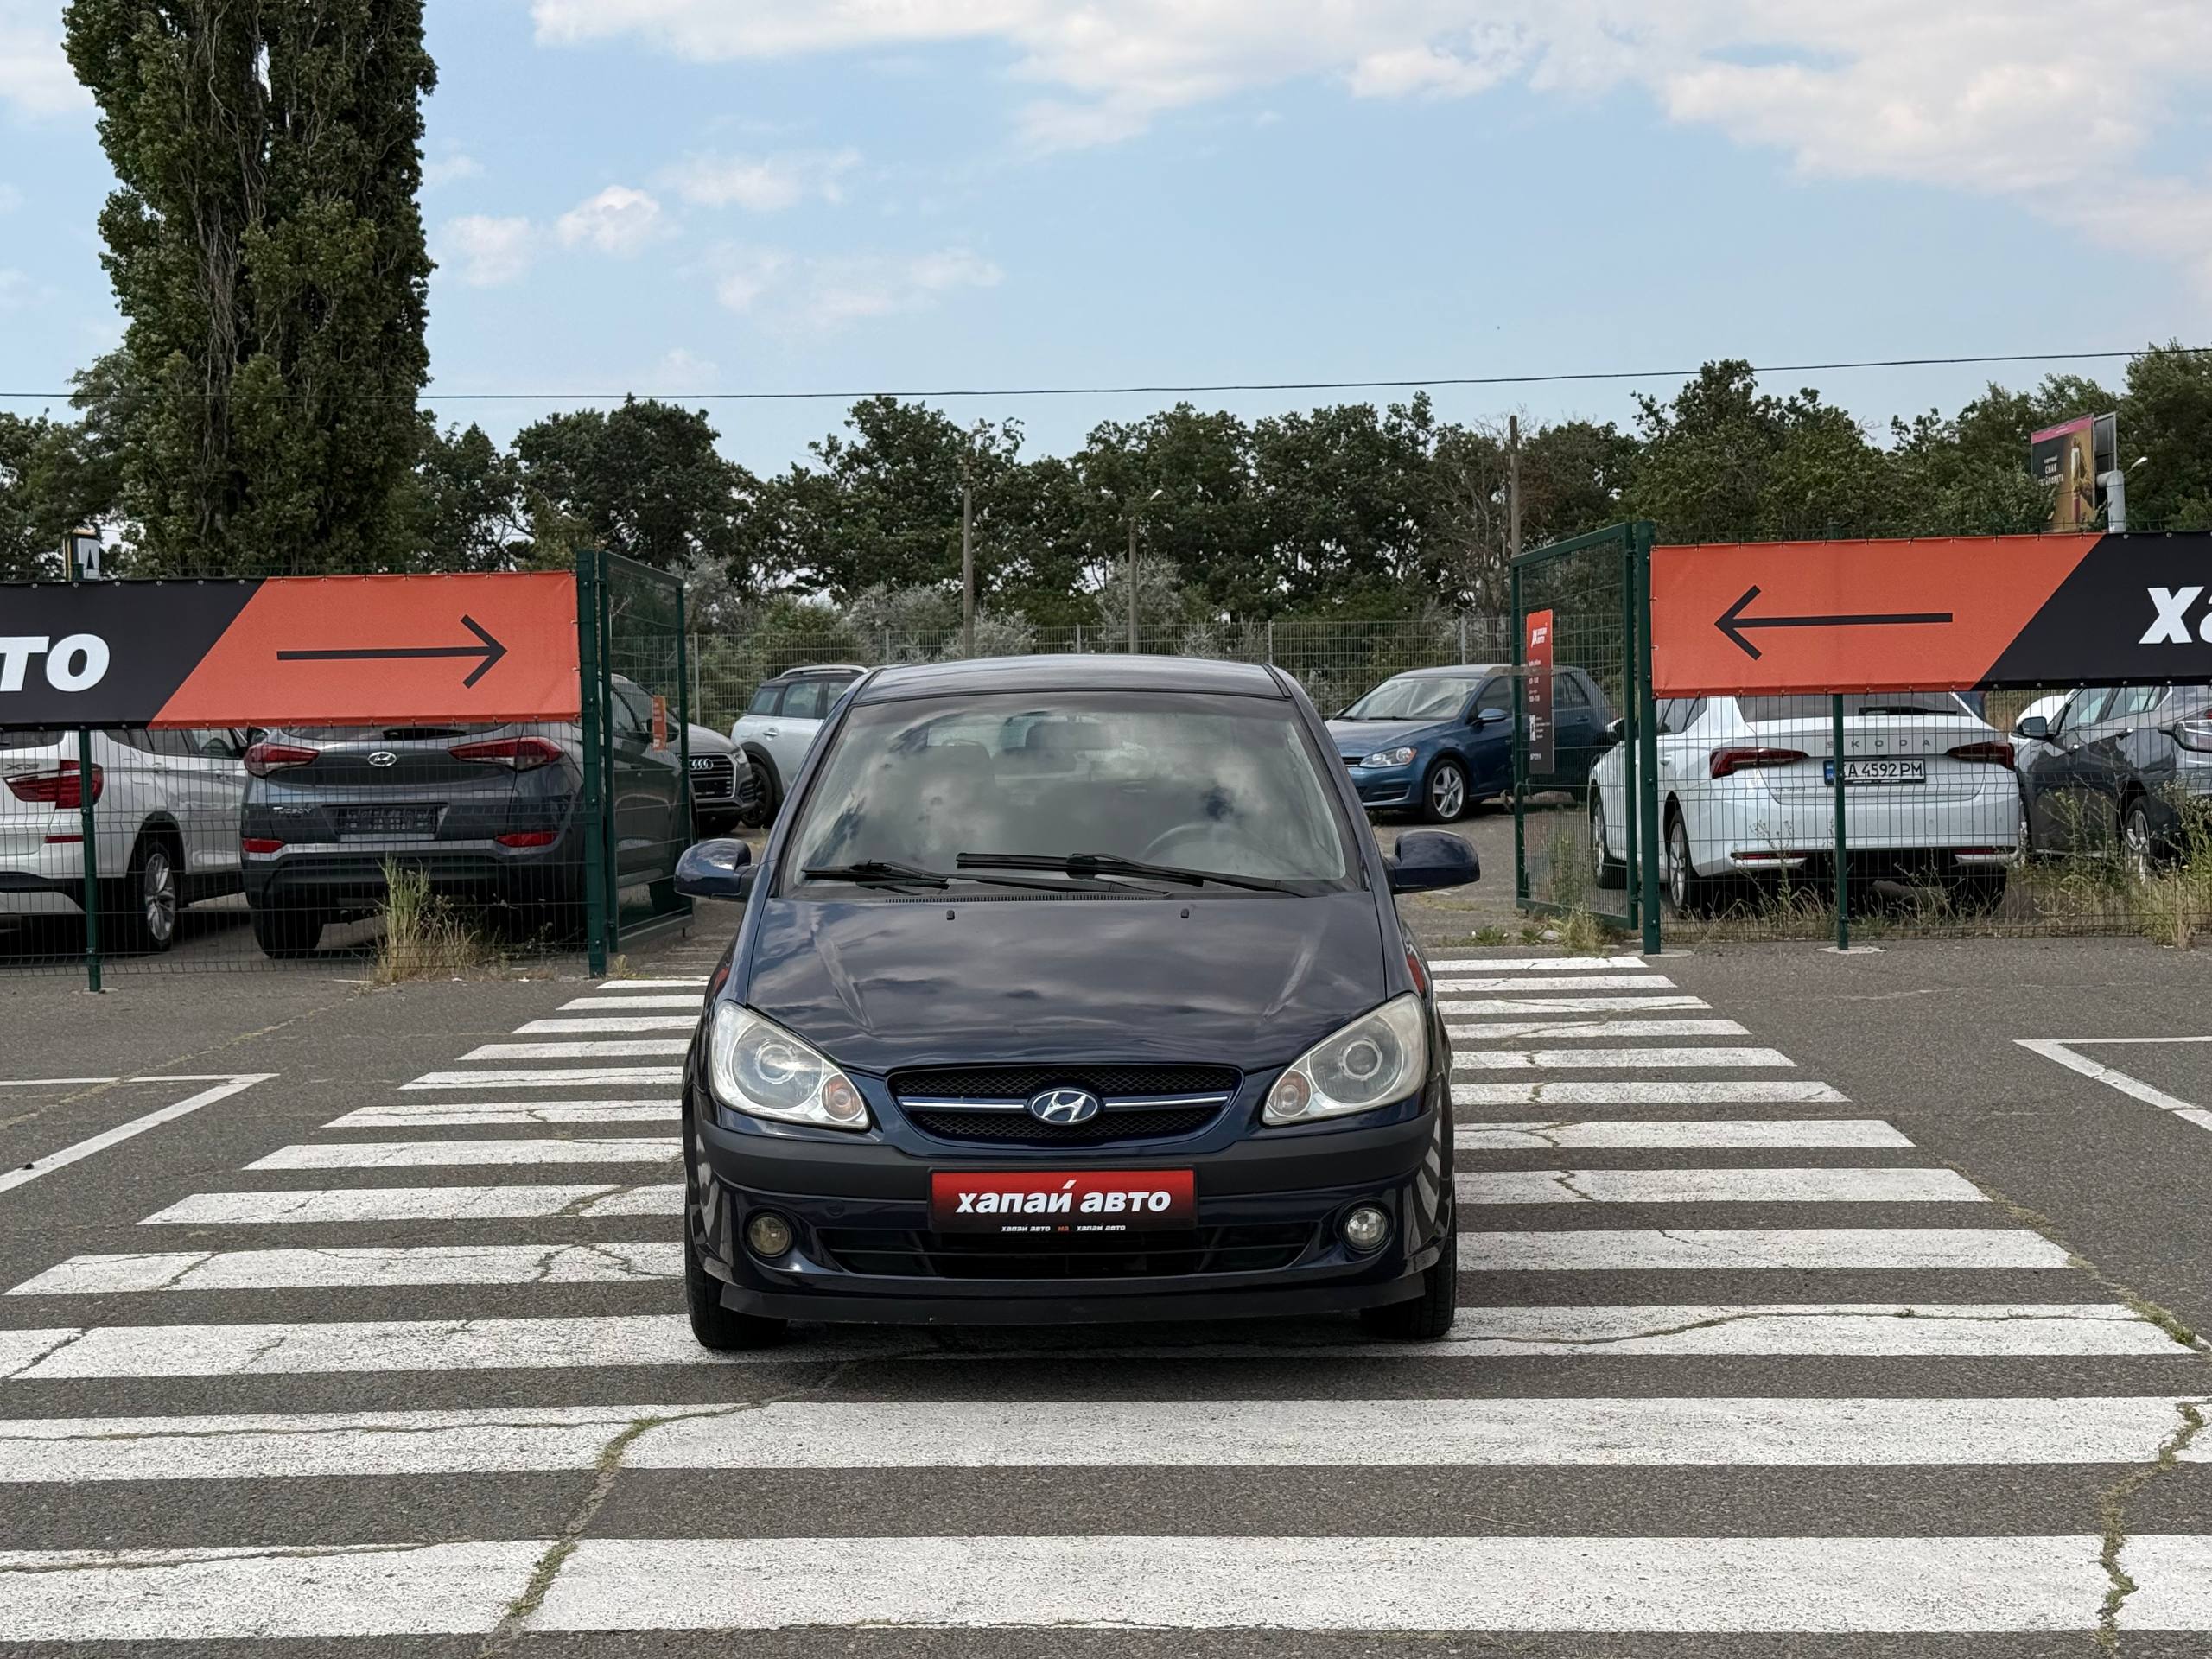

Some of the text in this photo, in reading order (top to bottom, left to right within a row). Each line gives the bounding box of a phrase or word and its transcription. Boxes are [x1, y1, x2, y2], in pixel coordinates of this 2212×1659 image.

[2138, 586, 2212, 644] х
[1861, 763, 1897, 777] 4592
[1900, 762, 1923, 777] PM
[955, 1179, 1172, 1214] хапай авто
